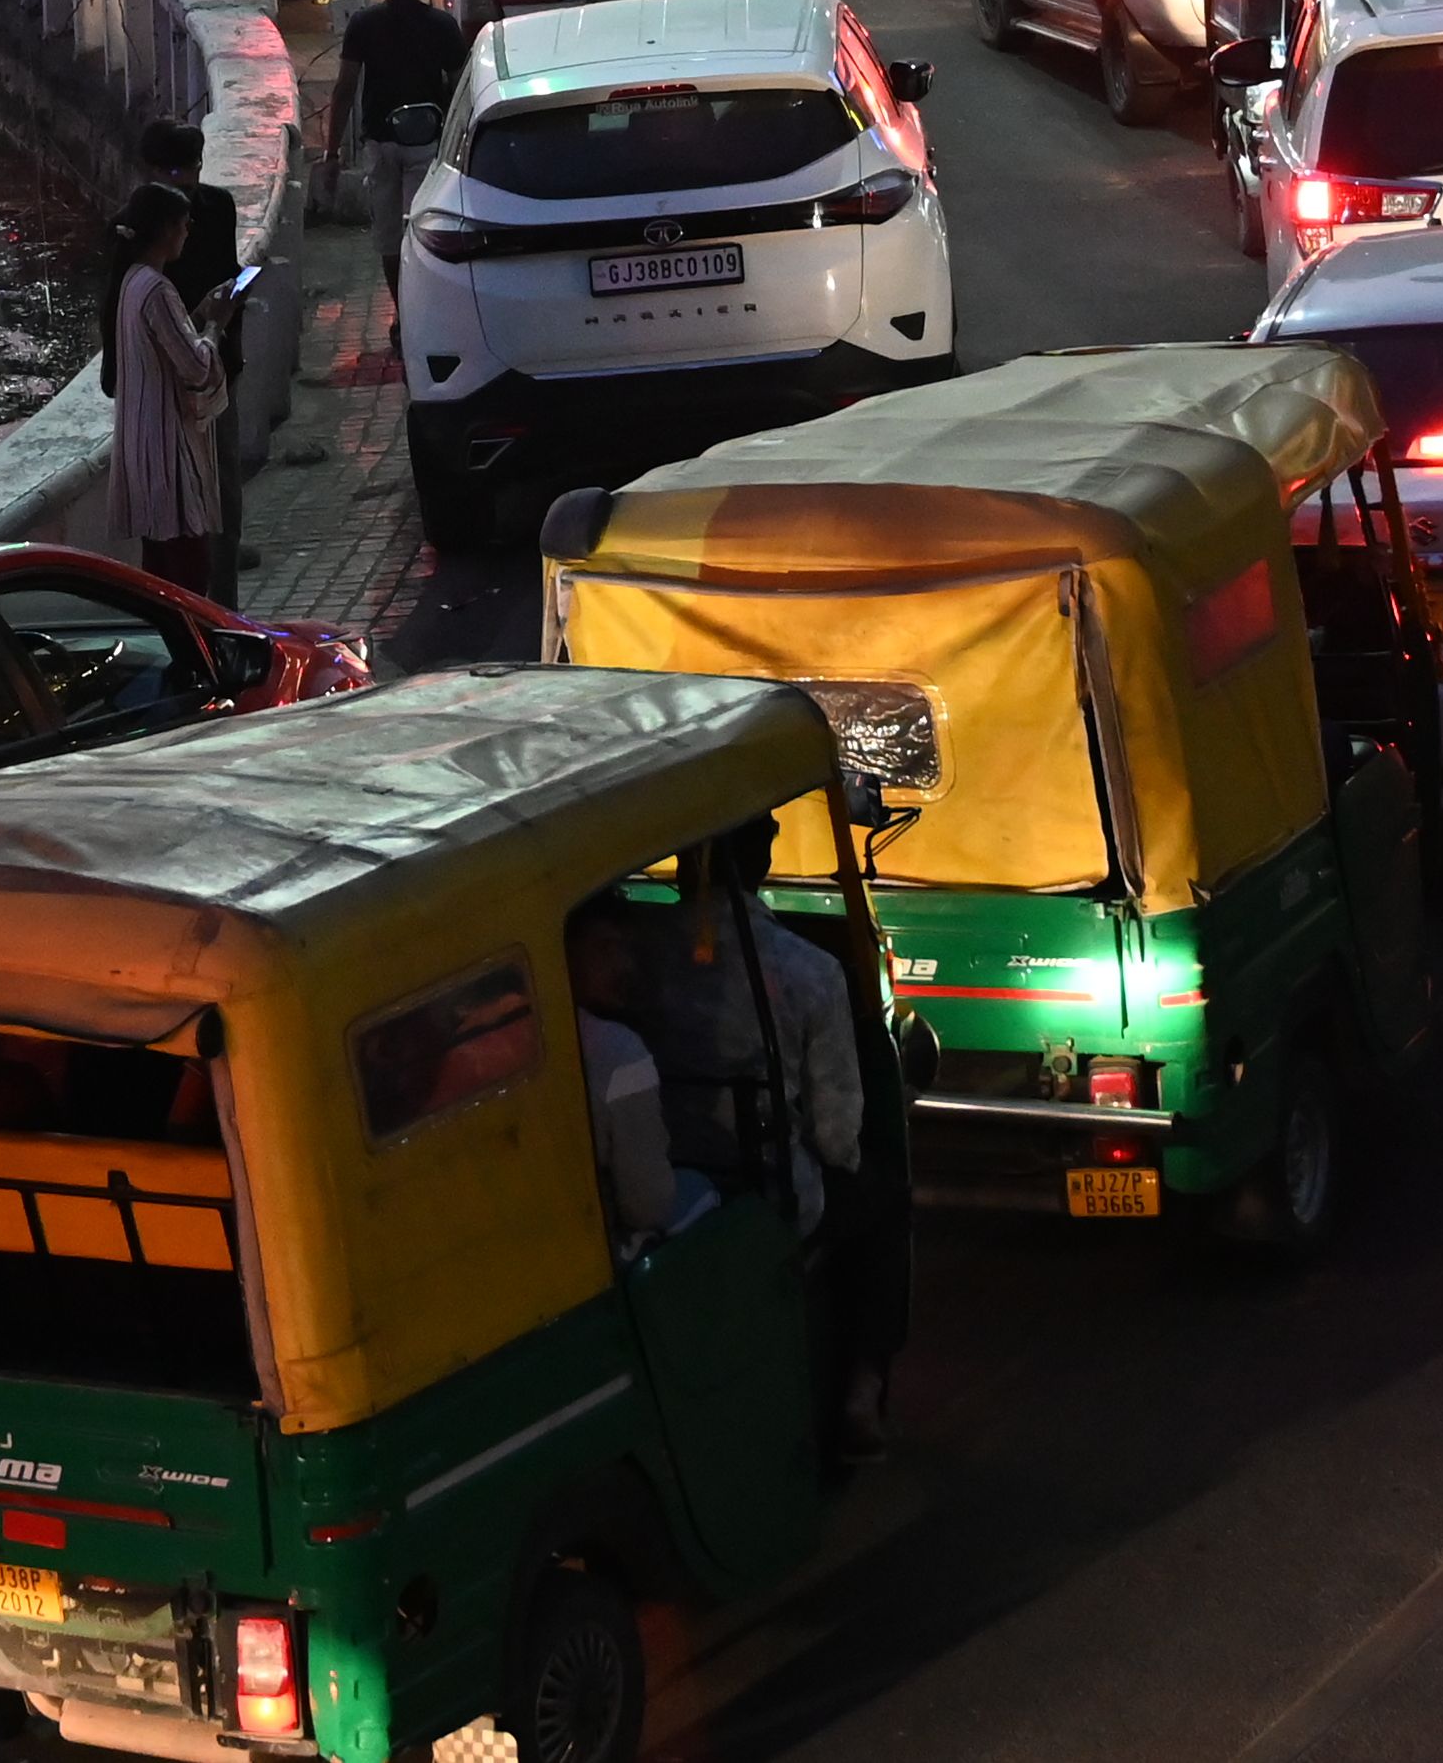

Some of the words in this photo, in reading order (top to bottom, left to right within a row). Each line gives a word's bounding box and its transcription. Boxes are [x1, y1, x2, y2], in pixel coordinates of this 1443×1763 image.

[608, 253, 737, 284] GJ38BC0109
[1084, 1172, 1142, 1192] RJ27P
[1086, 1194, 1145, 1214] B3665
